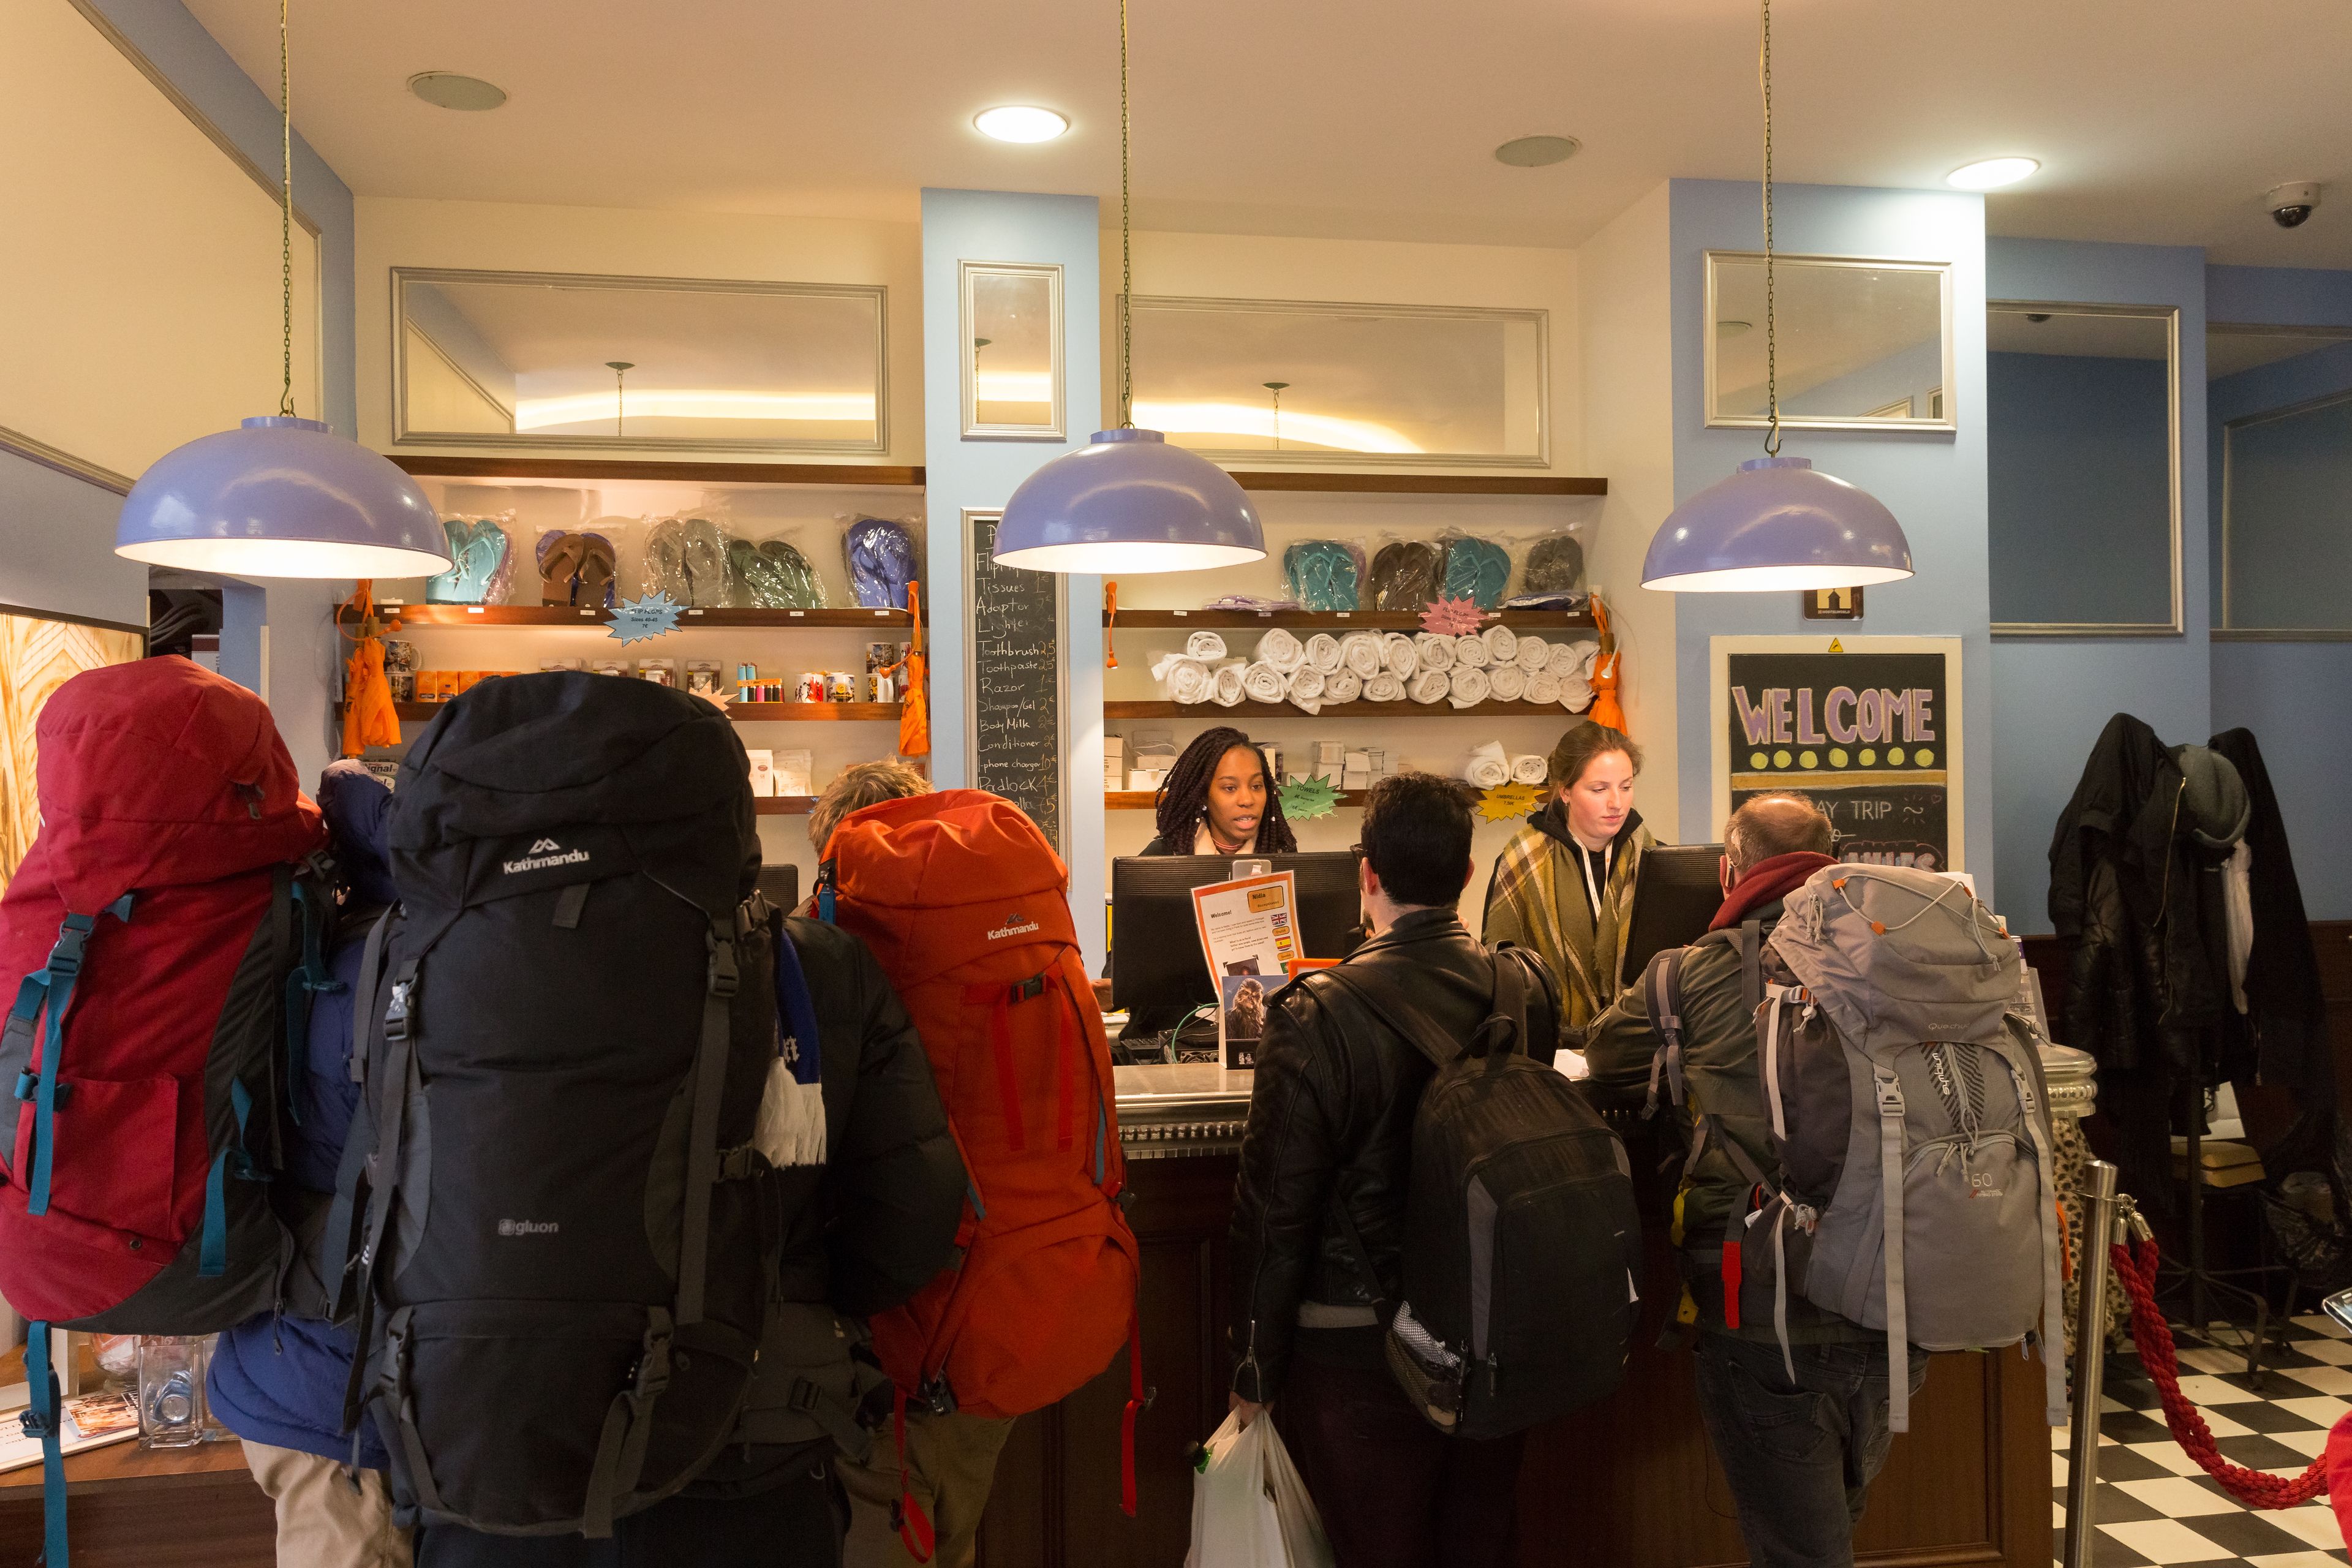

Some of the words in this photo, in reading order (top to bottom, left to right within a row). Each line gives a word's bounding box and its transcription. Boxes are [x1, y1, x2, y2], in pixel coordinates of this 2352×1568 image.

[976, 578, 1025, 595] Tissues
[976, 596, 1029, 617] Adaptor
[978, 618, 1028, 639] Lighter
[977, 640, 1039, 657] Toothbrush
[977, 660, 1038, 679] Toothpaste
[980, 677, 1025, 694] Razor
[1732, 685, 1936, 745] WELCOME
[980, 718, 1004, 734] Body
[1006, 717, 1031, 729] Milk
[978, 734, 1041, 752] Conditioner
[365, 764, 393, 773] ignal
[1297, 785, 1320, 794] TOWELS
[1817, 800, 1839, 820] AY
[1851, 801, 1892, 820] TRIP
[503, 848, 590, 875] Kathmandu
[1210, 910, 1232, 918] Welcome!
[987, 921, 1039, 940] Kathmandu
[1972, 1173, 1993, 1187] 60
